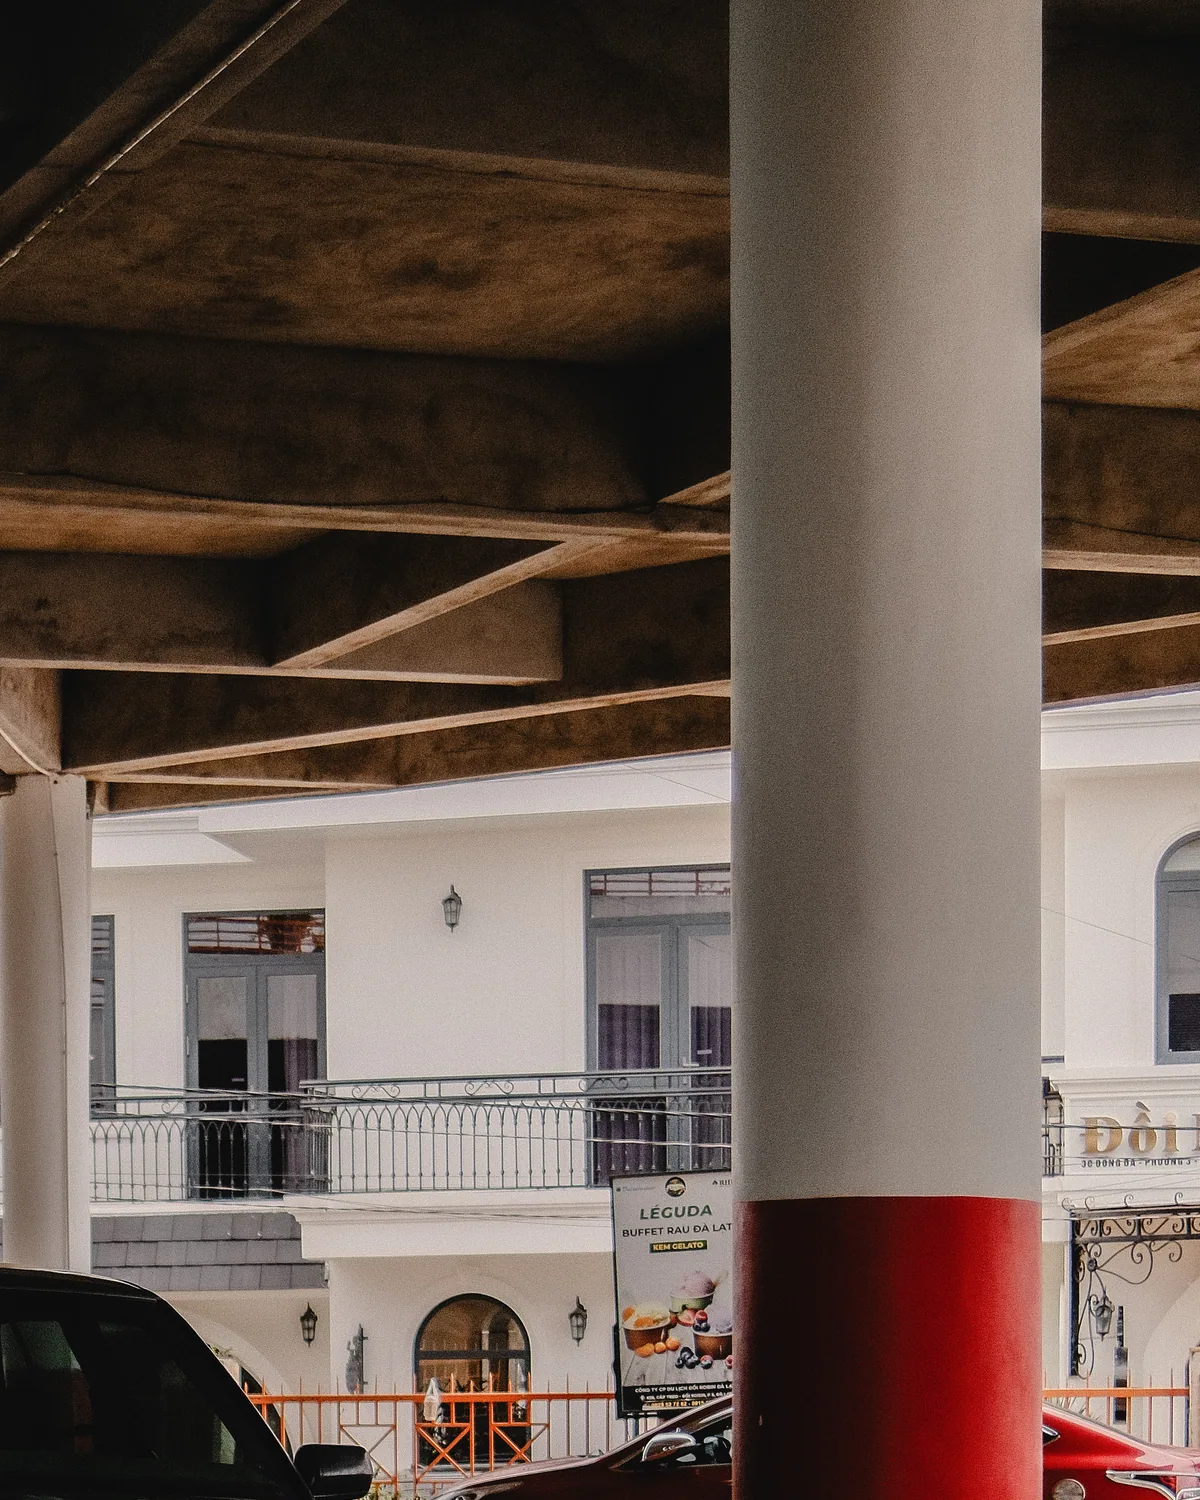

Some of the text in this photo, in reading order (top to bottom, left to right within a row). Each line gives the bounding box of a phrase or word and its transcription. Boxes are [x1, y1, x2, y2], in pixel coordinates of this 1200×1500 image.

[1080, 1101, 1179, 1154] Đồi
[640, 1204, 713, 1220] LÉGUDA
[622, 1227, 664, 1238] BUFFET
[667, 1225, 690, 1235] RAU
[693, 1222, 710, 1233] ĐÀ
[653, 1241, 704, 1251] KEM GELATO
